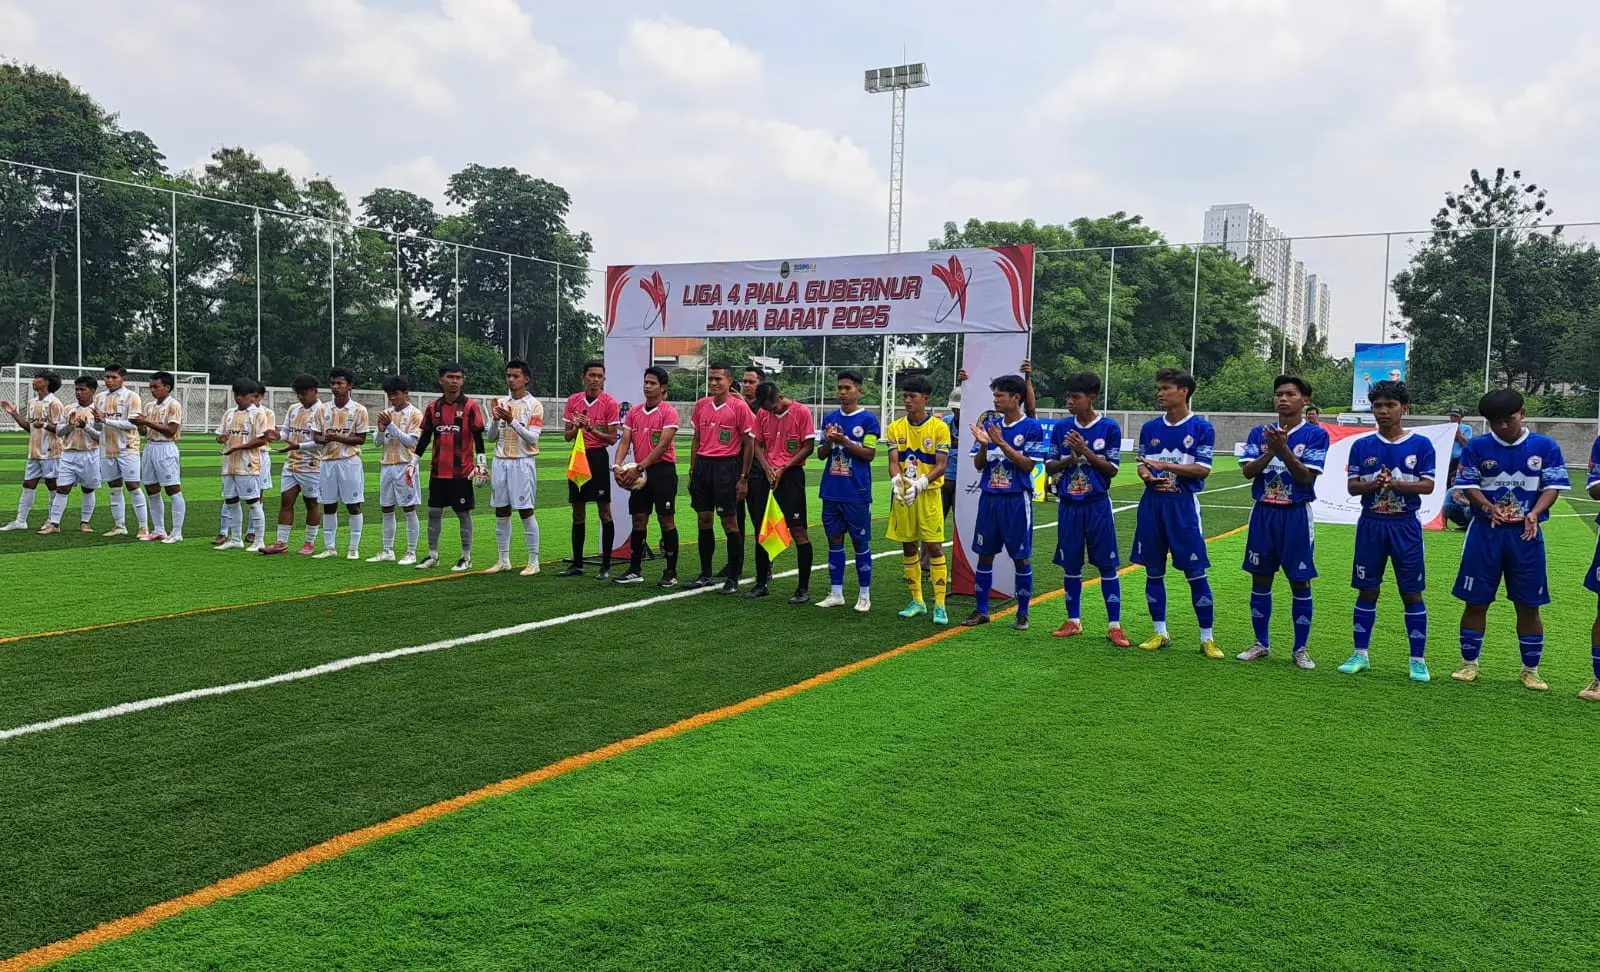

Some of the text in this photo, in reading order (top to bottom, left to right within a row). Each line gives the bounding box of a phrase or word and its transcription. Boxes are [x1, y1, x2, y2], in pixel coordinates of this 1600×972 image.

[682, 276, 923, 306] LIGA 4 PIALA GUBERNUR
[706, 305, 891, 331] JAWA BARAT 2025
[1248, 549, 1260, 565] 26
[1355, 564, 1366, 579] 15
[1463, 575, 1475, 590] 11
